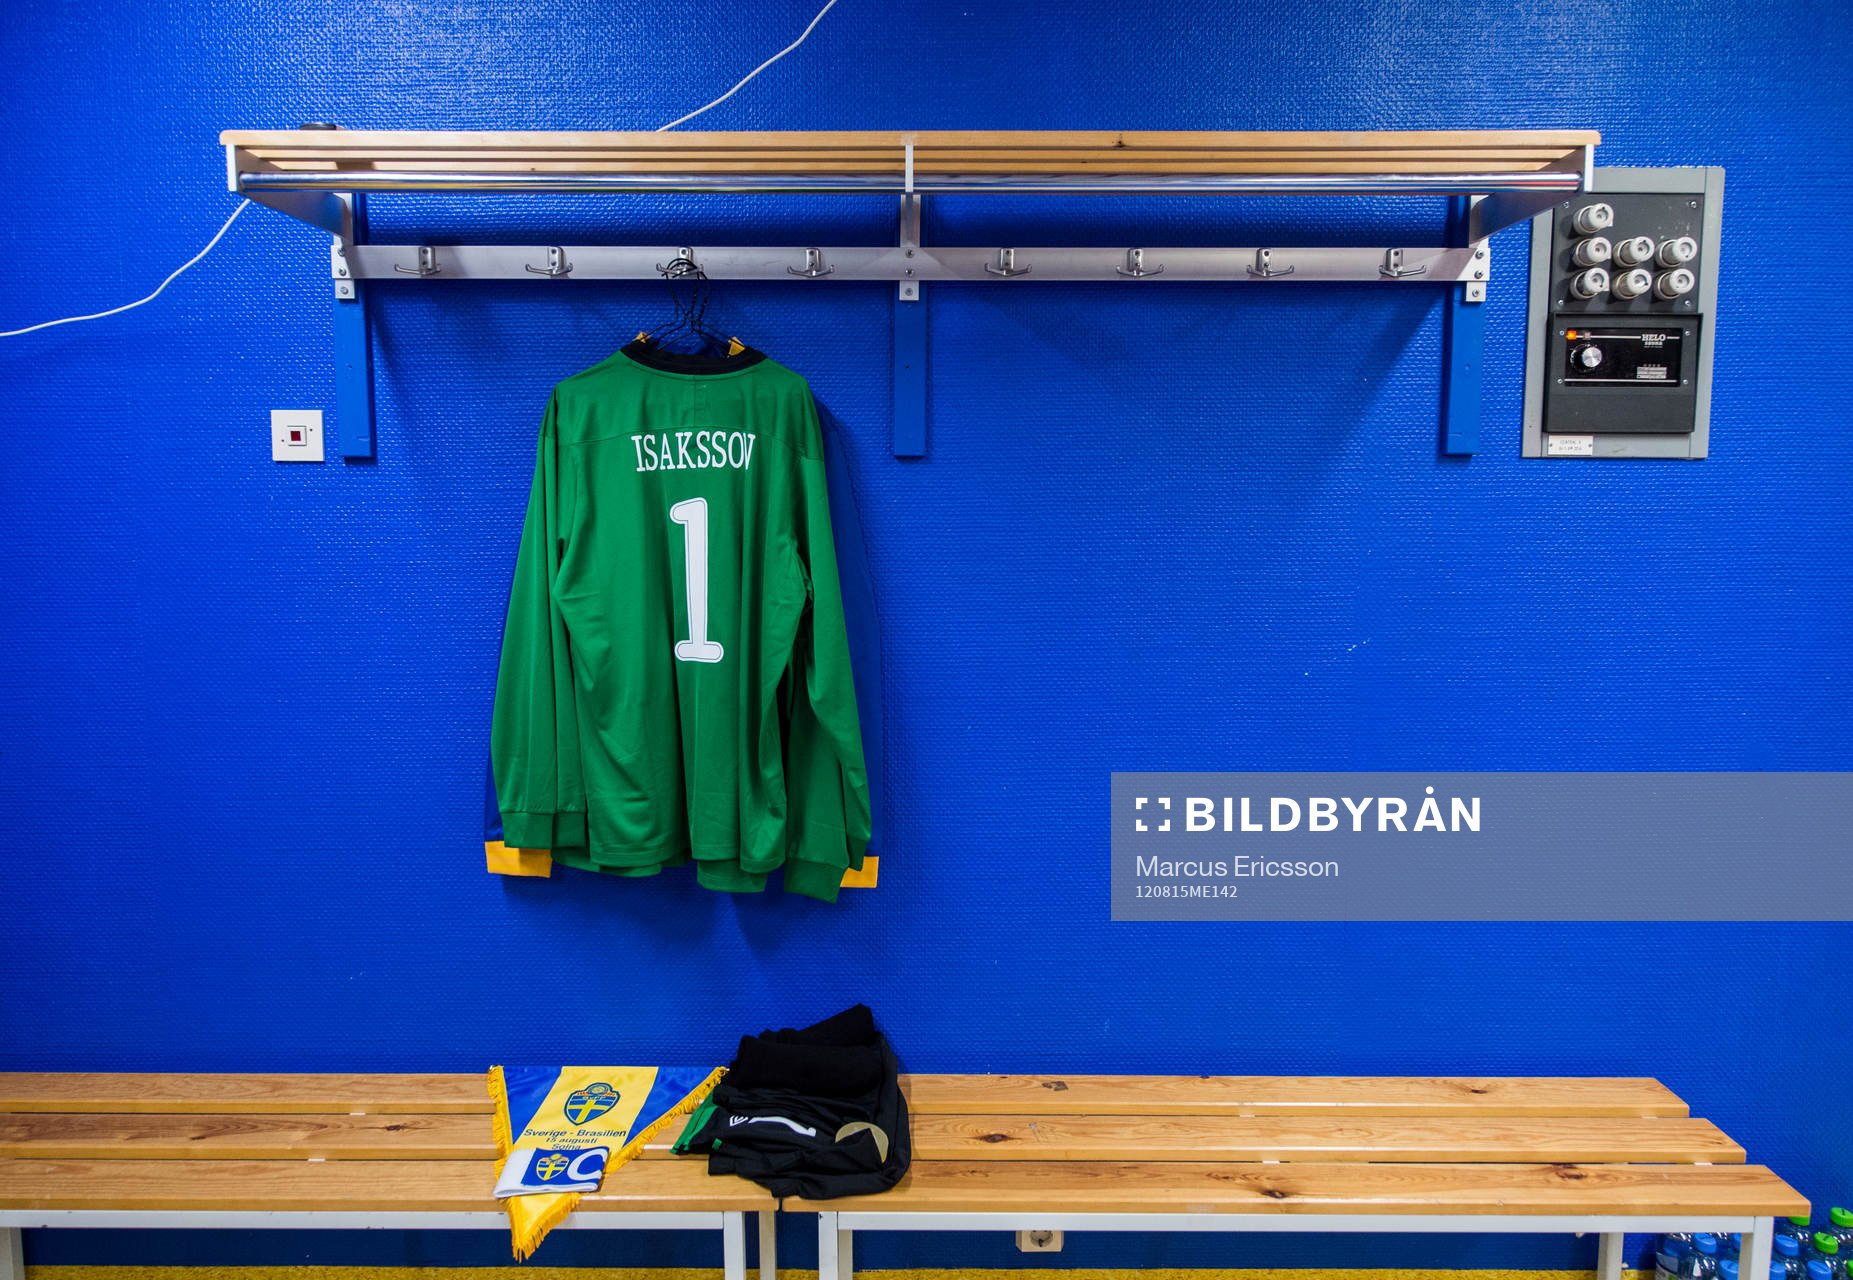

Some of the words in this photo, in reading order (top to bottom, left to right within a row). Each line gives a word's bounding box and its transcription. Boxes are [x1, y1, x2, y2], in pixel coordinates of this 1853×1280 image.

[1641, 333, 1666, 342] HELO
[669, 497, 724, 663] 1
[524, 1129, 567, 1137] Sverige
[566, 1147, 608, 1182] C
